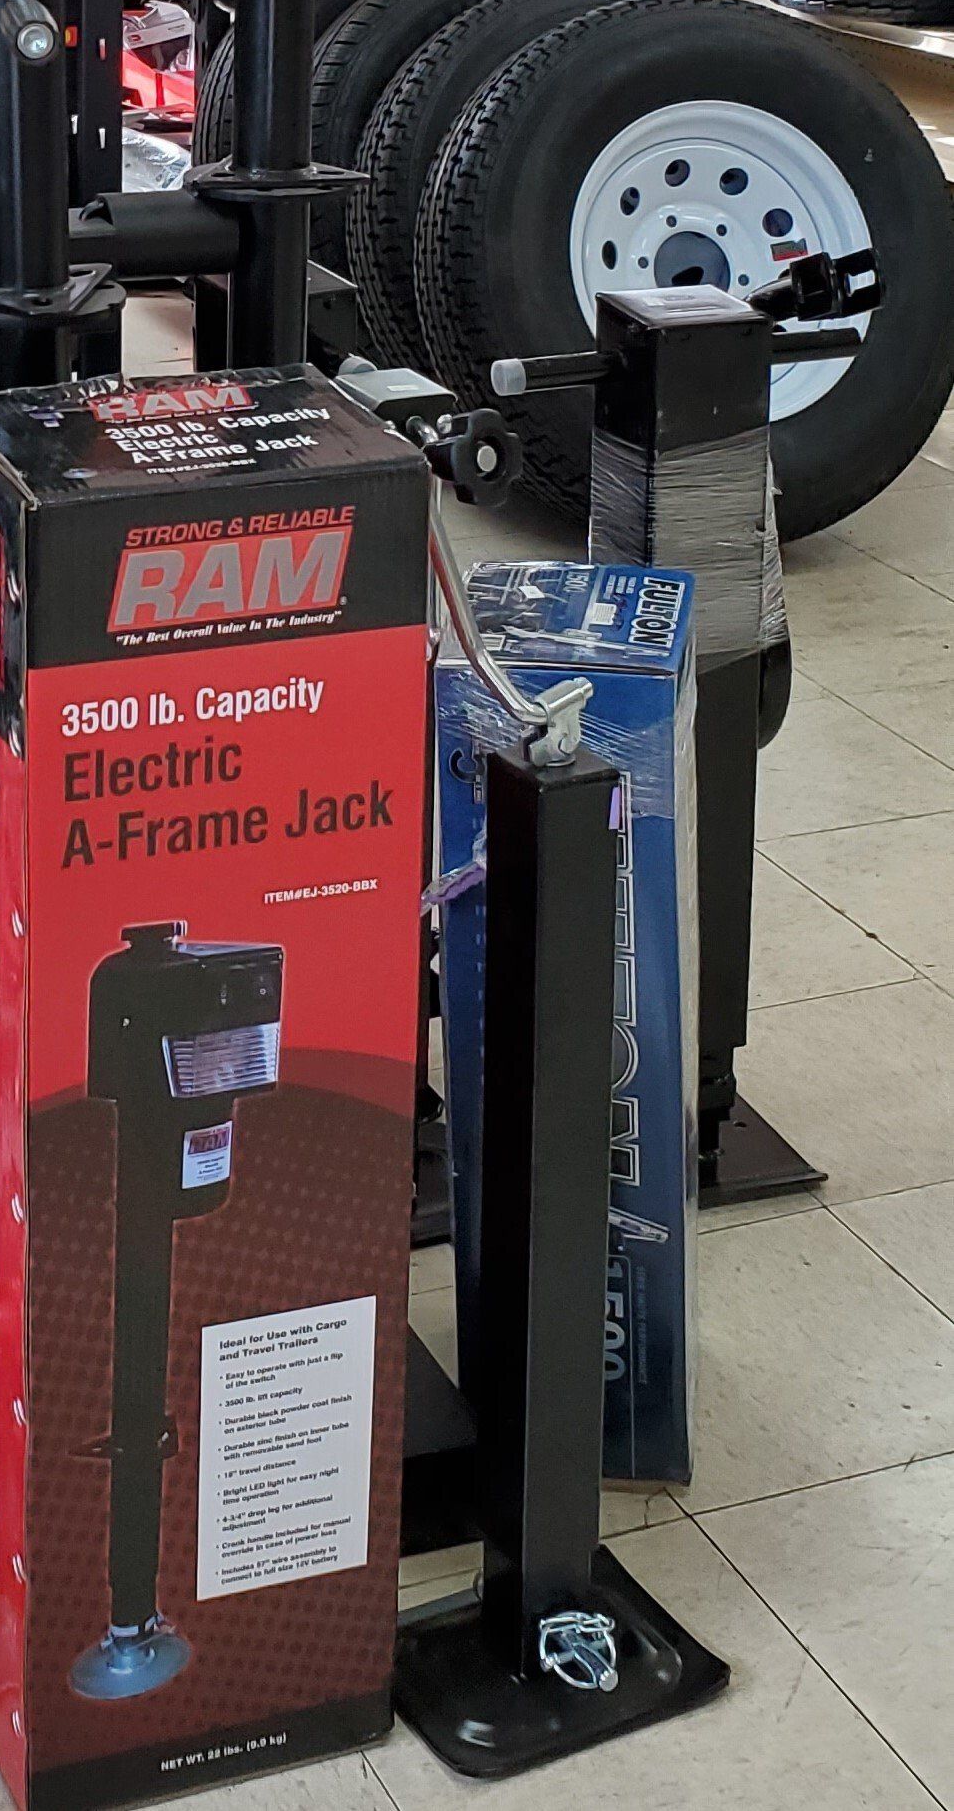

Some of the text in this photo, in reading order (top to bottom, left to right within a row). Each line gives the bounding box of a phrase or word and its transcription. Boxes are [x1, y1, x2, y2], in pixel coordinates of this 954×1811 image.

[98, 388, 247, 419] RAM
[105, 424, 174, 439] 3500
[177, 421, 215, 432] lb.
[218, 408, 330, 428] Capacity
[116, 433, 218, 452] Electric
[132, 434, 319, 464] A-Frame Jack
[125, 506, 355, 546] STRONG & RELIABLE
[114, 532, 344, 626] RAM
[628, 576, 685, 649] FULTON
[146, 631, 169, 643] Best
[173, 625, 211, 639] Overall
[218, 622, 246, 635] Value
[249, 620, 261, 631] In
[266, 617, 285, 629] The
[61, 677, 324, 737] 3500 lb. Capacity
[64, 737, 242, 803] Electric
[61, 781, 393, 868] A-Frame Jack
[264, 879, 377, 904] ITEM#EJ-3520-BBX
[220, 1320, 347, 1349] Ideal for Use with Cargo
[220, 1337, 318, 1361] and Travel Trailers
[226, 1371, 244, 1380] Easy
[257, 1364, 286, 1374] operate
[289, 1359, 305, 1367] with
[307, 1355, 321, 1366] just
[250, 1375, 275, 1384] switch
[225, 1397, 244, 1407] 3500
[270, 1387, 302, 1399] capacity
[225, 1415, 255, 1425] Durable
[281, 1404, 310, 1415] powder
[331, 1394, 352, 1404] finish
[224, 1441, 254, 1452] Durable
[275, 1432, 296, 1441] finish
[224, 1453, 240, 1461] with
[239, 1460, 296, 1475] travel distance
[224, 1486, 247, 1496] Bright
[250, 1483, 265, 1491] LED
[268, 1478, 284, 1488] light
[320, 1467, 338, 1477] night
[242, 1490, 279, 1502] operation
[248, 1509, 266, 1518] drop
[161, 1758, 183, 1771] NET
[186, 1753, 204, 1765] WT.
[224, 1746, 243, 1757] lbs.
